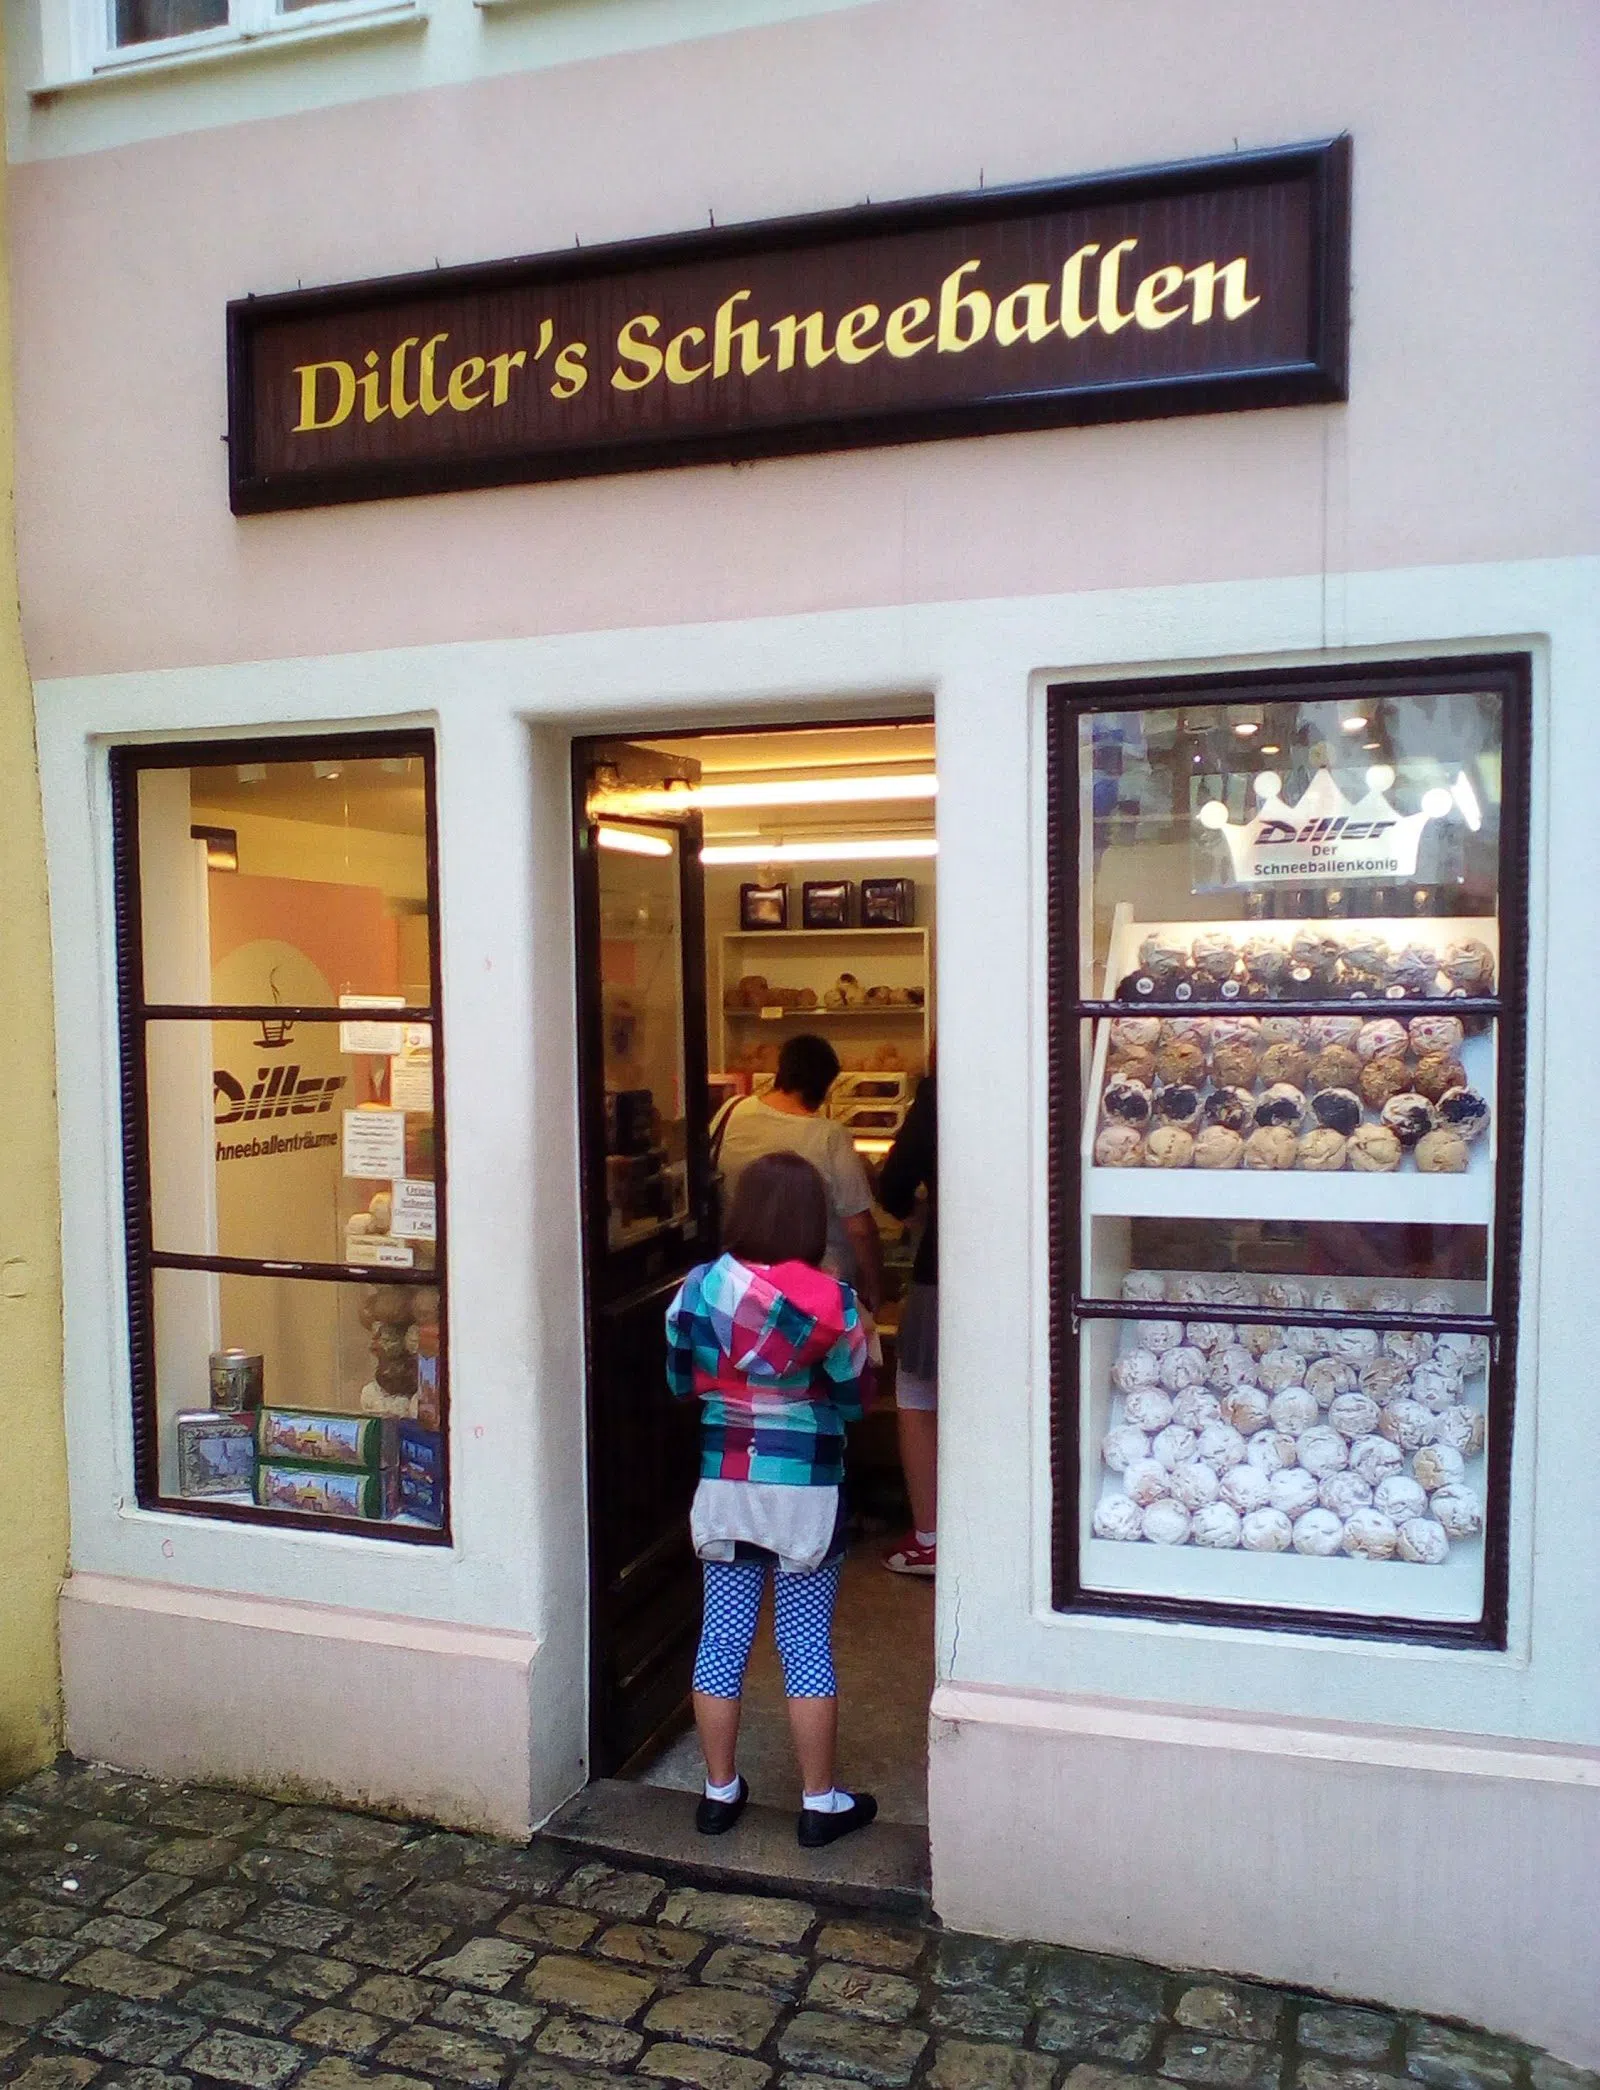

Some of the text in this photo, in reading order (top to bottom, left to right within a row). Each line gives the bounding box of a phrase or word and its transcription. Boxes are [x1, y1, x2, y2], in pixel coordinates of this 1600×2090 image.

[611, 238, 1260, 391] Schneeballen
[1254, 816, 1397, 845] Diller
[1311, 844, 1339, 857] Der
